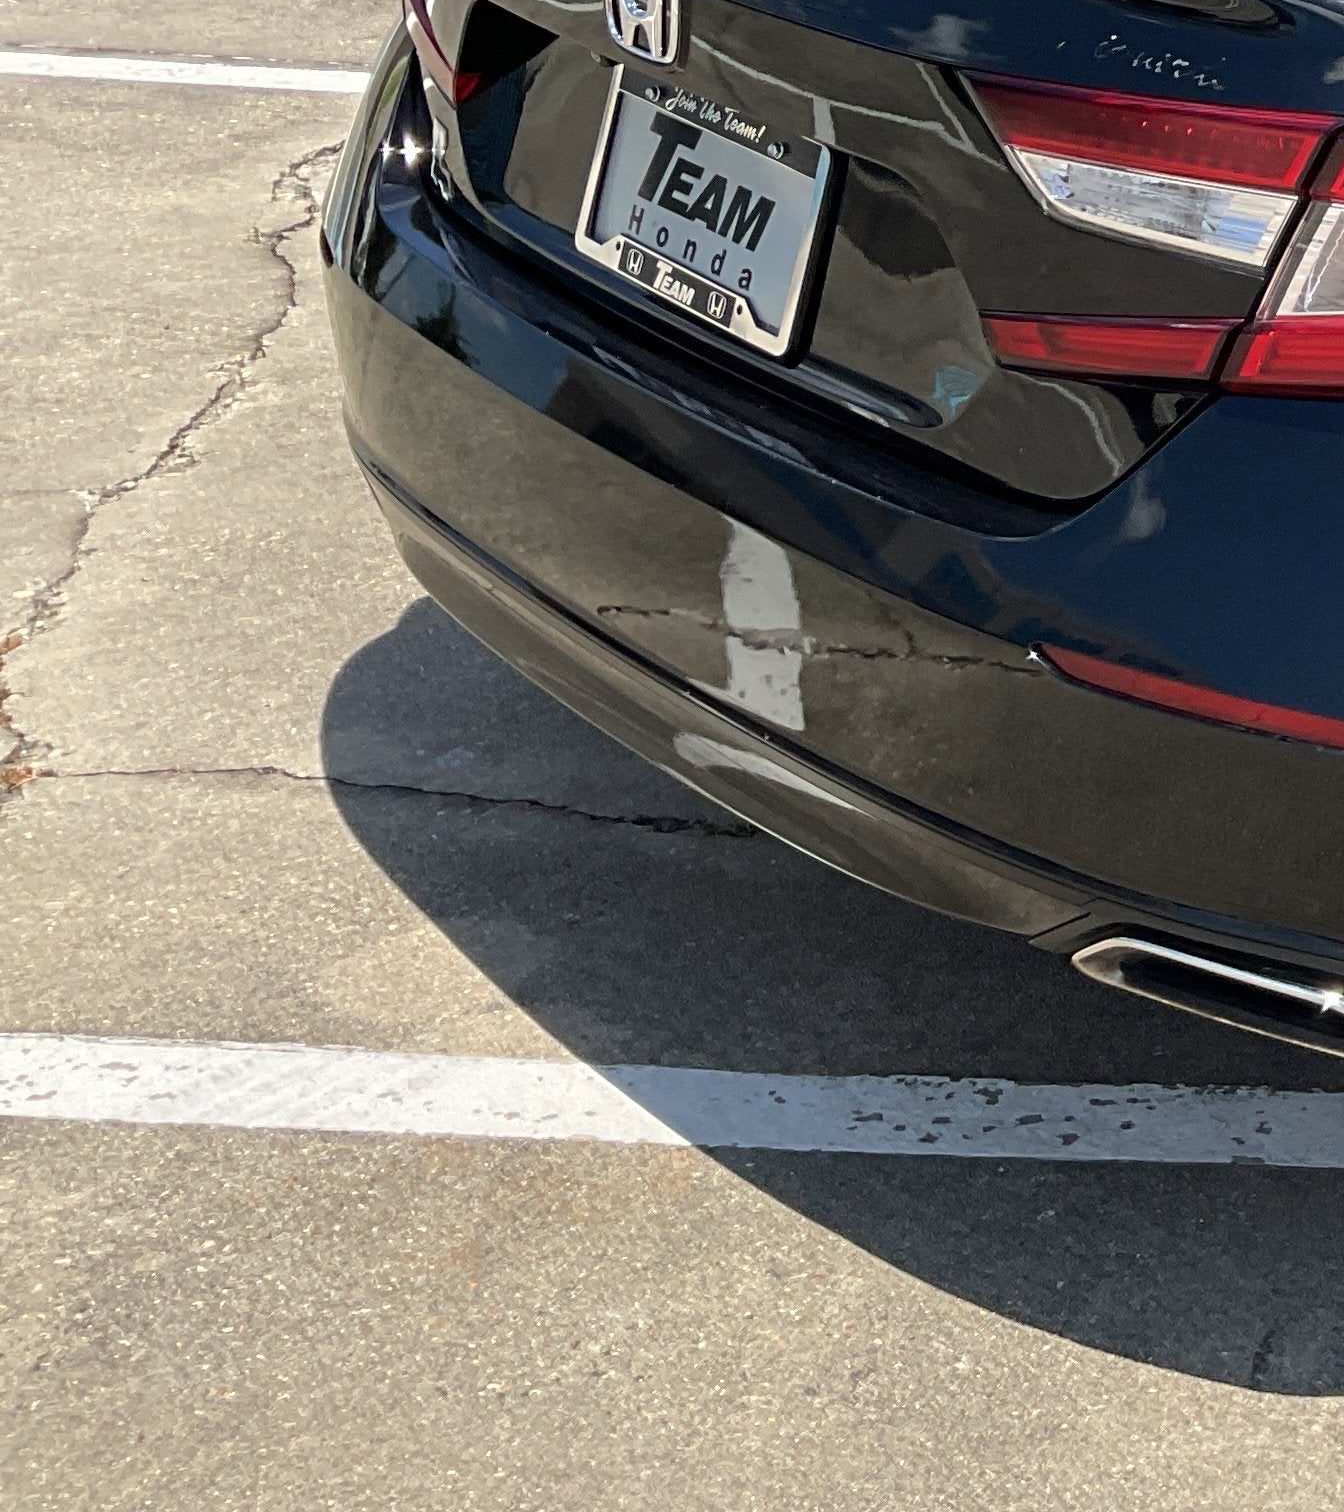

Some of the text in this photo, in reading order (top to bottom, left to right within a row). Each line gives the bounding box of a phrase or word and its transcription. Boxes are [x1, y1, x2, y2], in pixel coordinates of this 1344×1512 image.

[665, 86, 697, 112] Join
[723, 106, 767, 144] Team!
[637, 111, 777, 252] TEAM
[628, 204, 753, 291] Honda
[652, 259, 696, 306] TEAM
